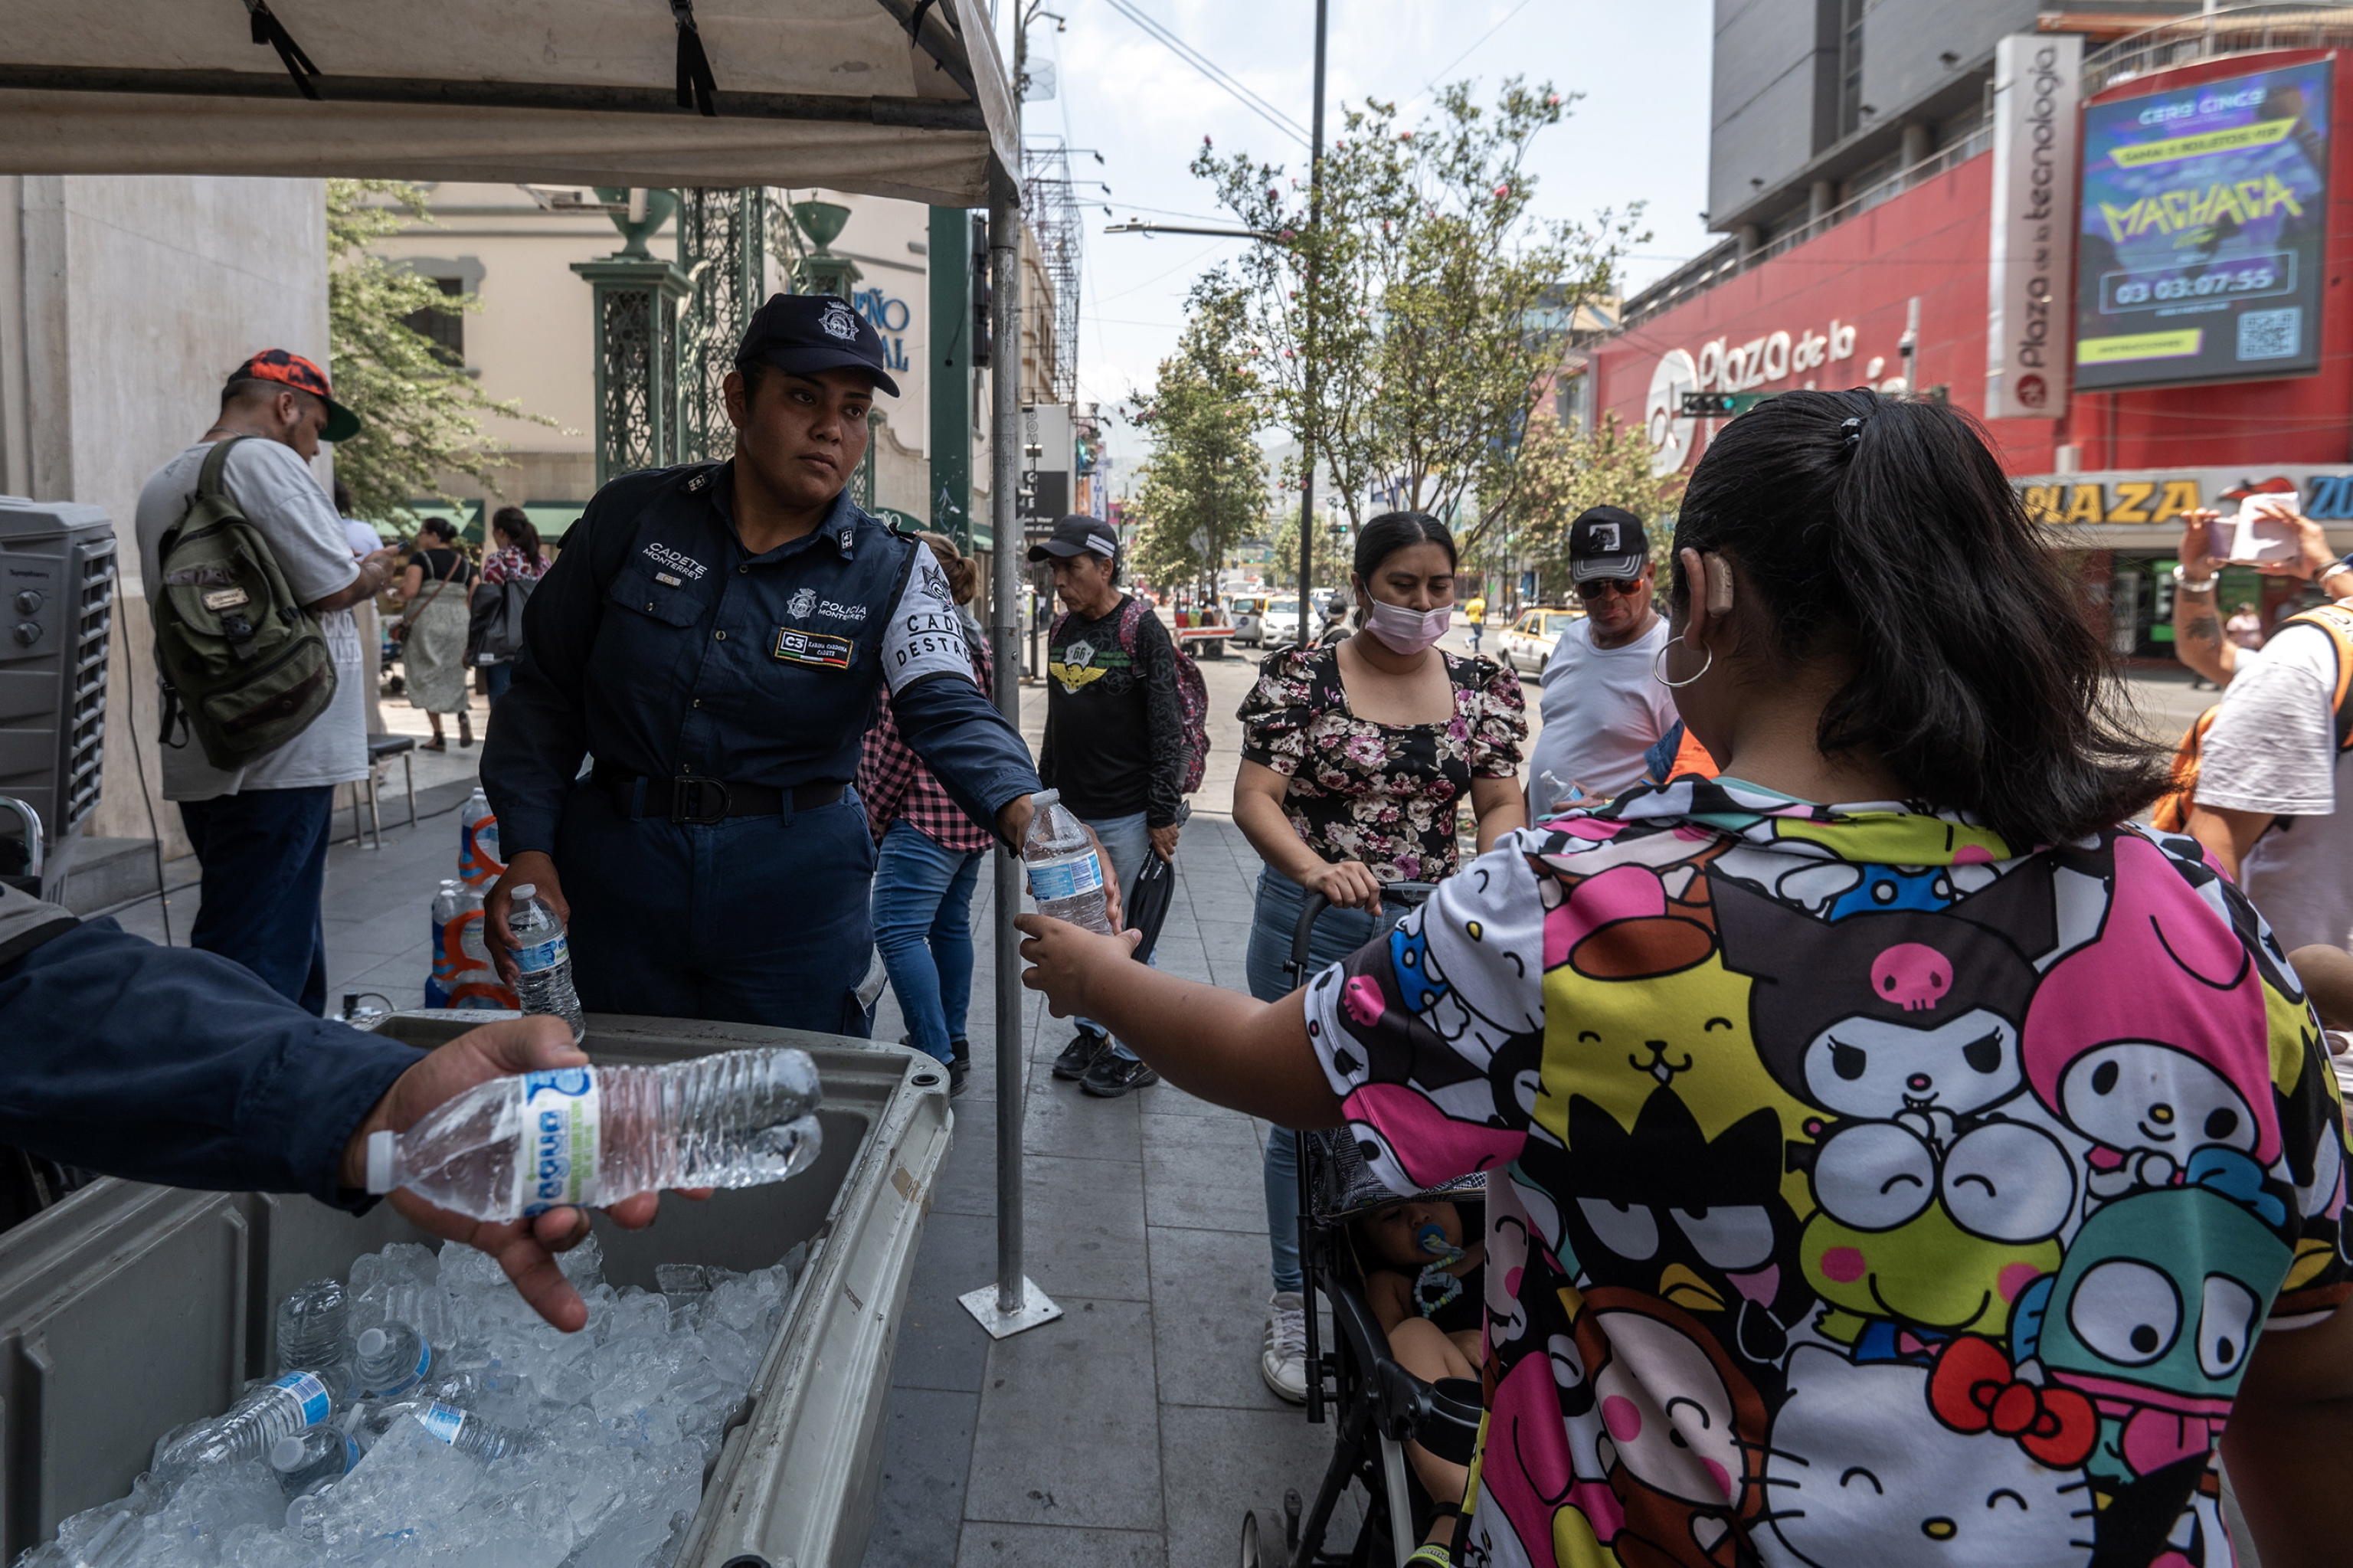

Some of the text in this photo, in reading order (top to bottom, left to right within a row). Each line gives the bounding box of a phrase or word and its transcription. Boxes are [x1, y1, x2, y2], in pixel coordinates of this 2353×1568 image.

[2138, 87, 2268, 125] CERO CINCO
[2099, 173, 2303, 242] MACHACA
[2018, 276, 2050, 368] Plaza
[1698, 319, 1857, 392] Plaza de la
[2021, 480, 2201, 525] PLAZA
[643, 548, 702, 581] MONTERREY
[650, 542, 708, 575] CADETE
[820, 601, 866, 615] POLICÍA
[785, 636, 805, 649] C3
[1072, 647, 1085, 660] 66
[538, 1110, 571, 1199] agua
